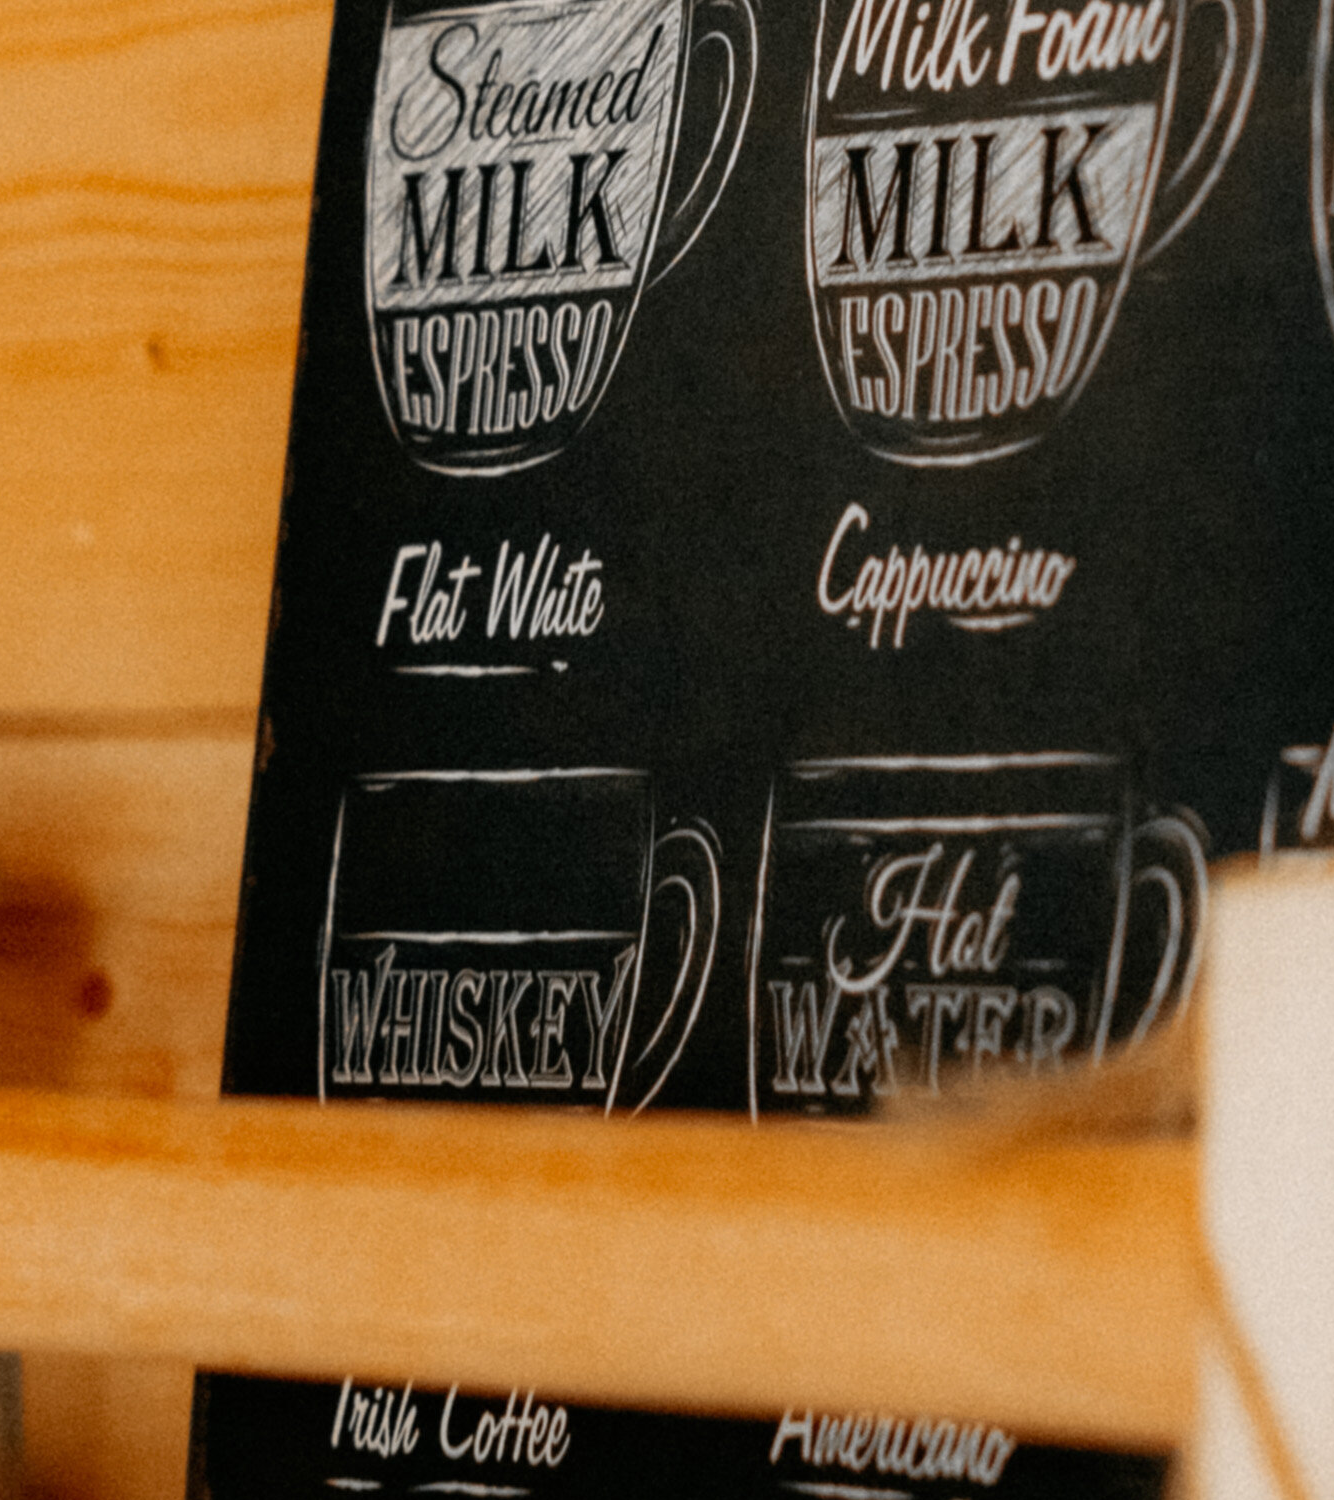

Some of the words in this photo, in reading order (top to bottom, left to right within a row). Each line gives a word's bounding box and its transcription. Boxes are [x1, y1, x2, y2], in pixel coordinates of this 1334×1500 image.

[390, 20, 664, 162] Steamed
[391, 147, 633, 288] MILK
[832, 119, 1119, 273] MILK
[391, 298, 617, 436] ESPRESSO
[838, 276, 1099, 423] ESPRESSO
[377, 541, 480, 648] Flat
[486, 532, 605, 640] White
[817, 502, 1075, 649] Cappuccino
[827, 842, 1021, 995] Hot
[331, 944, 635, 1090] WHISKEY
